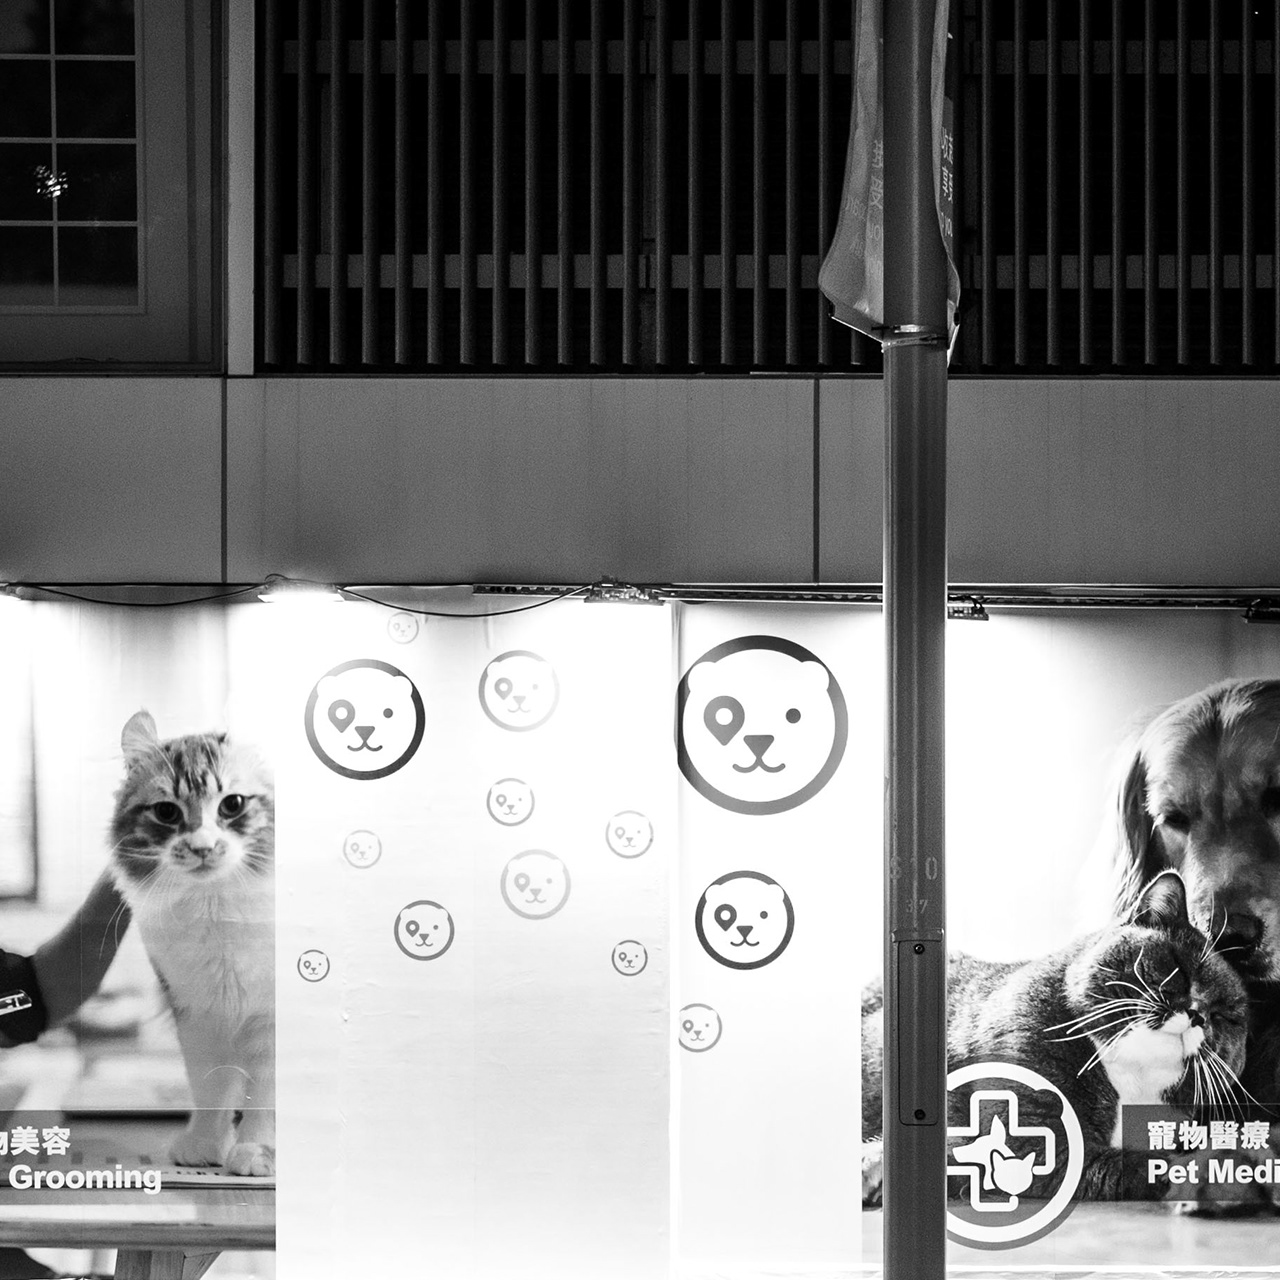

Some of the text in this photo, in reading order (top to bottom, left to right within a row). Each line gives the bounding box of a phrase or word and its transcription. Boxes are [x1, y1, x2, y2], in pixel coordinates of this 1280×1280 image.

[1147, 1120, 1270, 1150] 寵物醫療
[8, 1163, 162, 1194] Grooming
[1147, 1158, 1199, 1184] Pet
